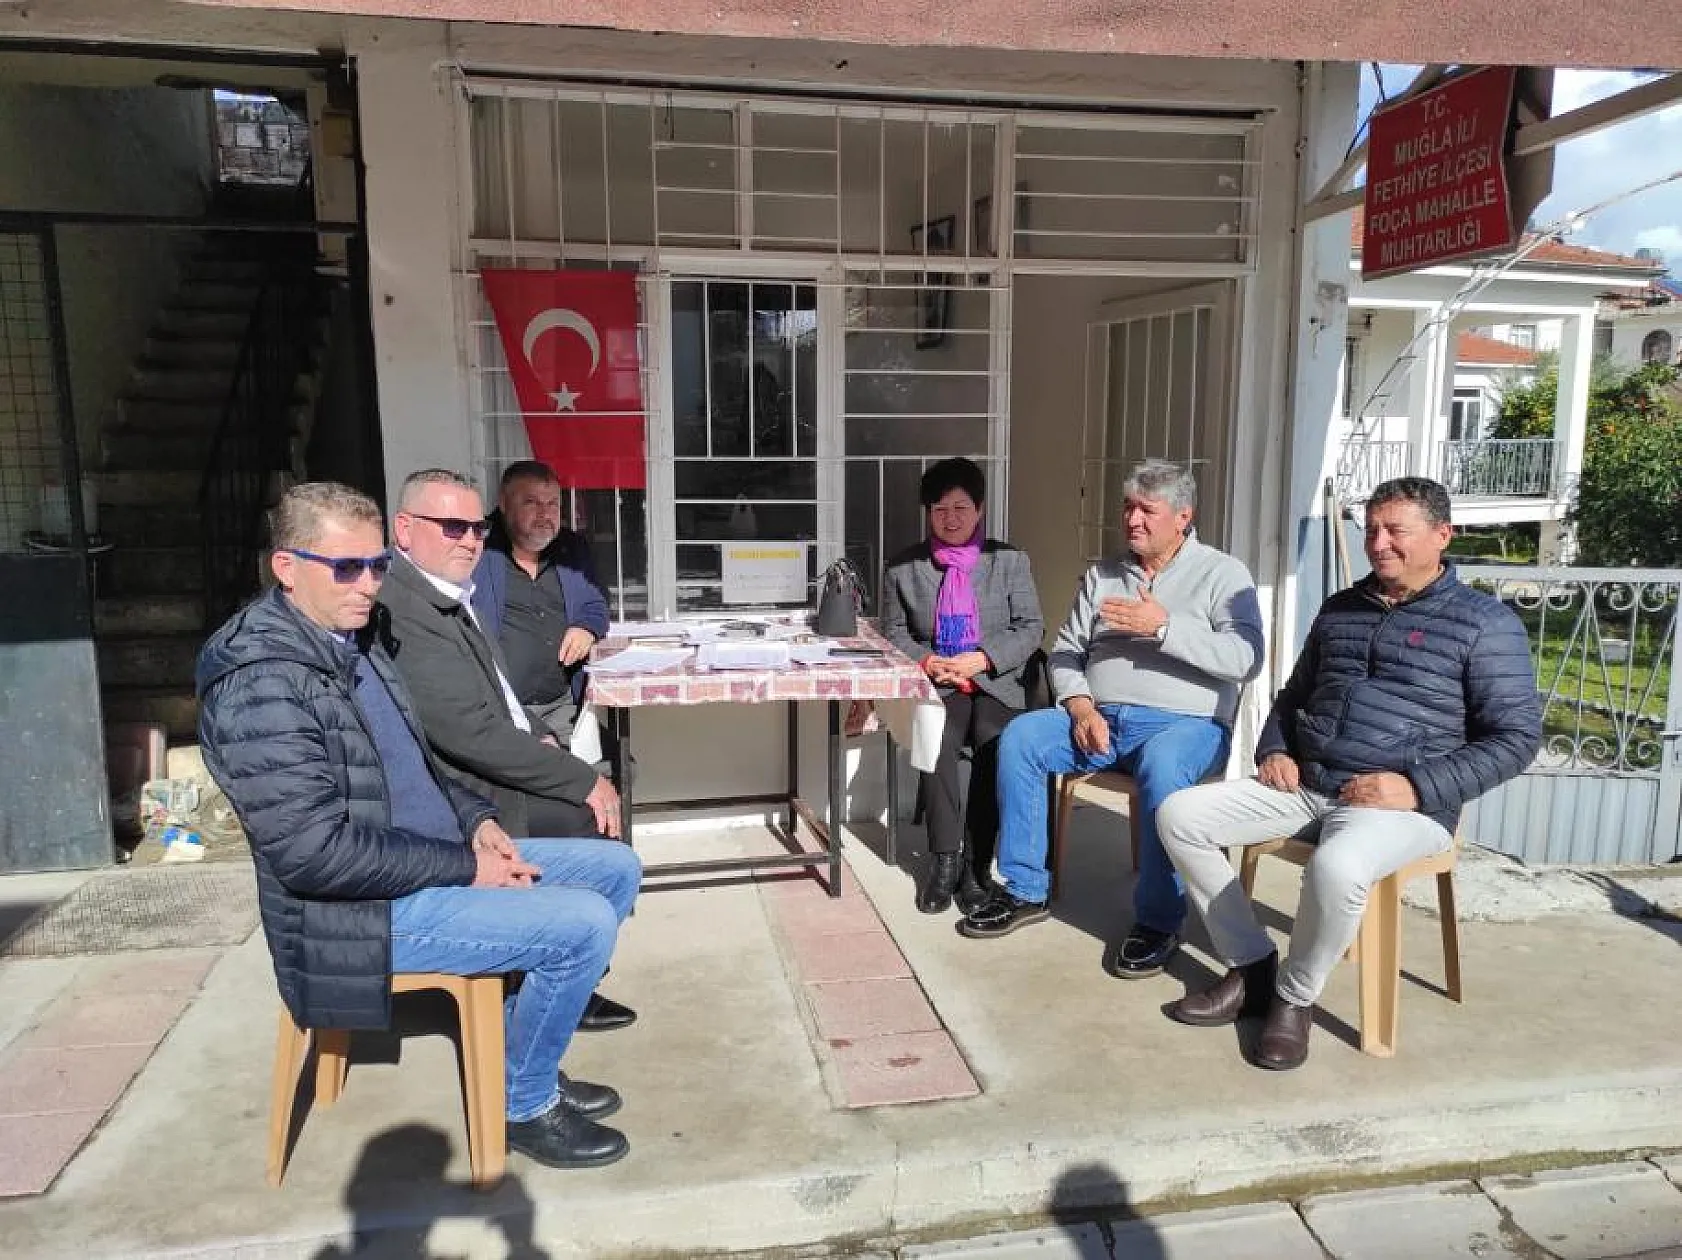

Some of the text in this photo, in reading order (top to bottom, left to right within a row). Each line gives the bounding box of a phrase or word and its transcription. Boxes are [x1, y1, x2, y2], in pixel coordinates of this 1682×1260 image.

[1394, 107, 1479, 165] MUĞLA İLİ
[1373, 135, 1492, 205] FETHİYE İLÇESİ
[1370, 179, 1499, 236] FOÇA MAHALLE
[1380, 213, 1481, 265] MUHTARLIĞI
